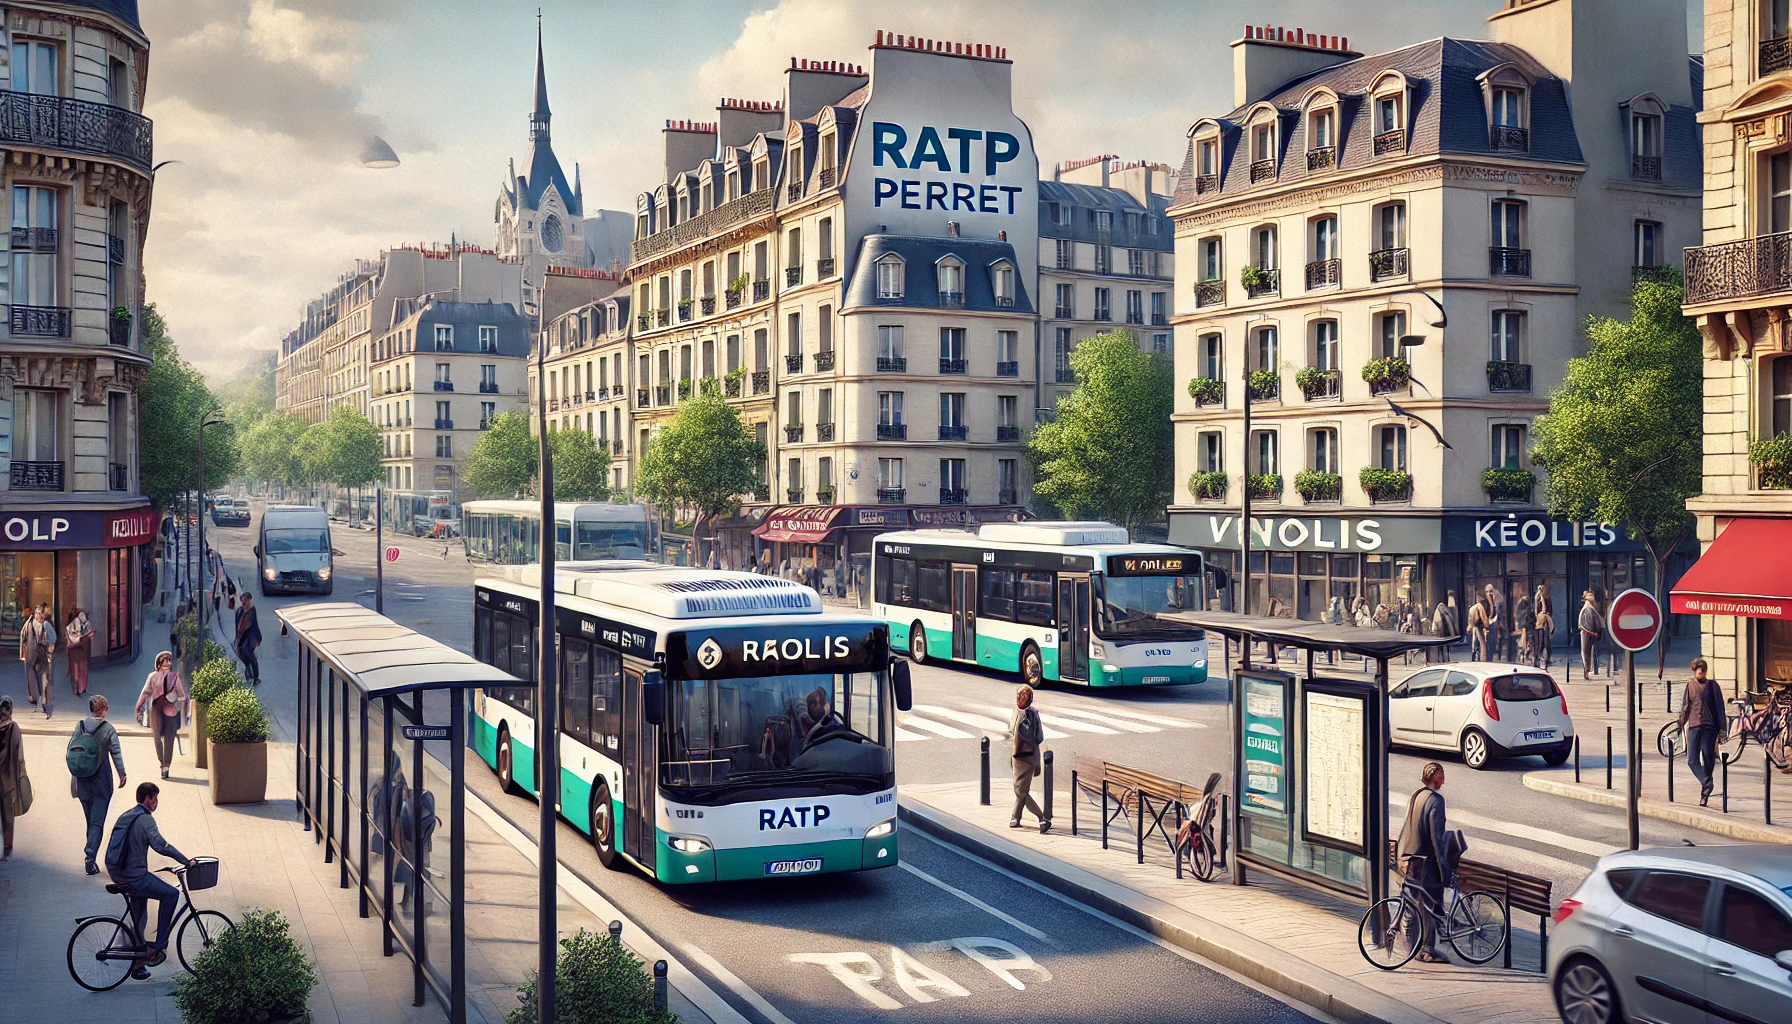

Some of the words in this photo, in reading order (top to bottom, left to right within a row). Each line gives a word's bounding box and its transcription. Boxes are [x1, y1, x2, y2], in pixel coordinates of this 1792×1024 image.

[872, 121, 1020, 176] RATP
[874, 177, 1023, 214] PERRET
[4, 517, 70, 541] OLP
[759, 804, 831, 831] RATP
